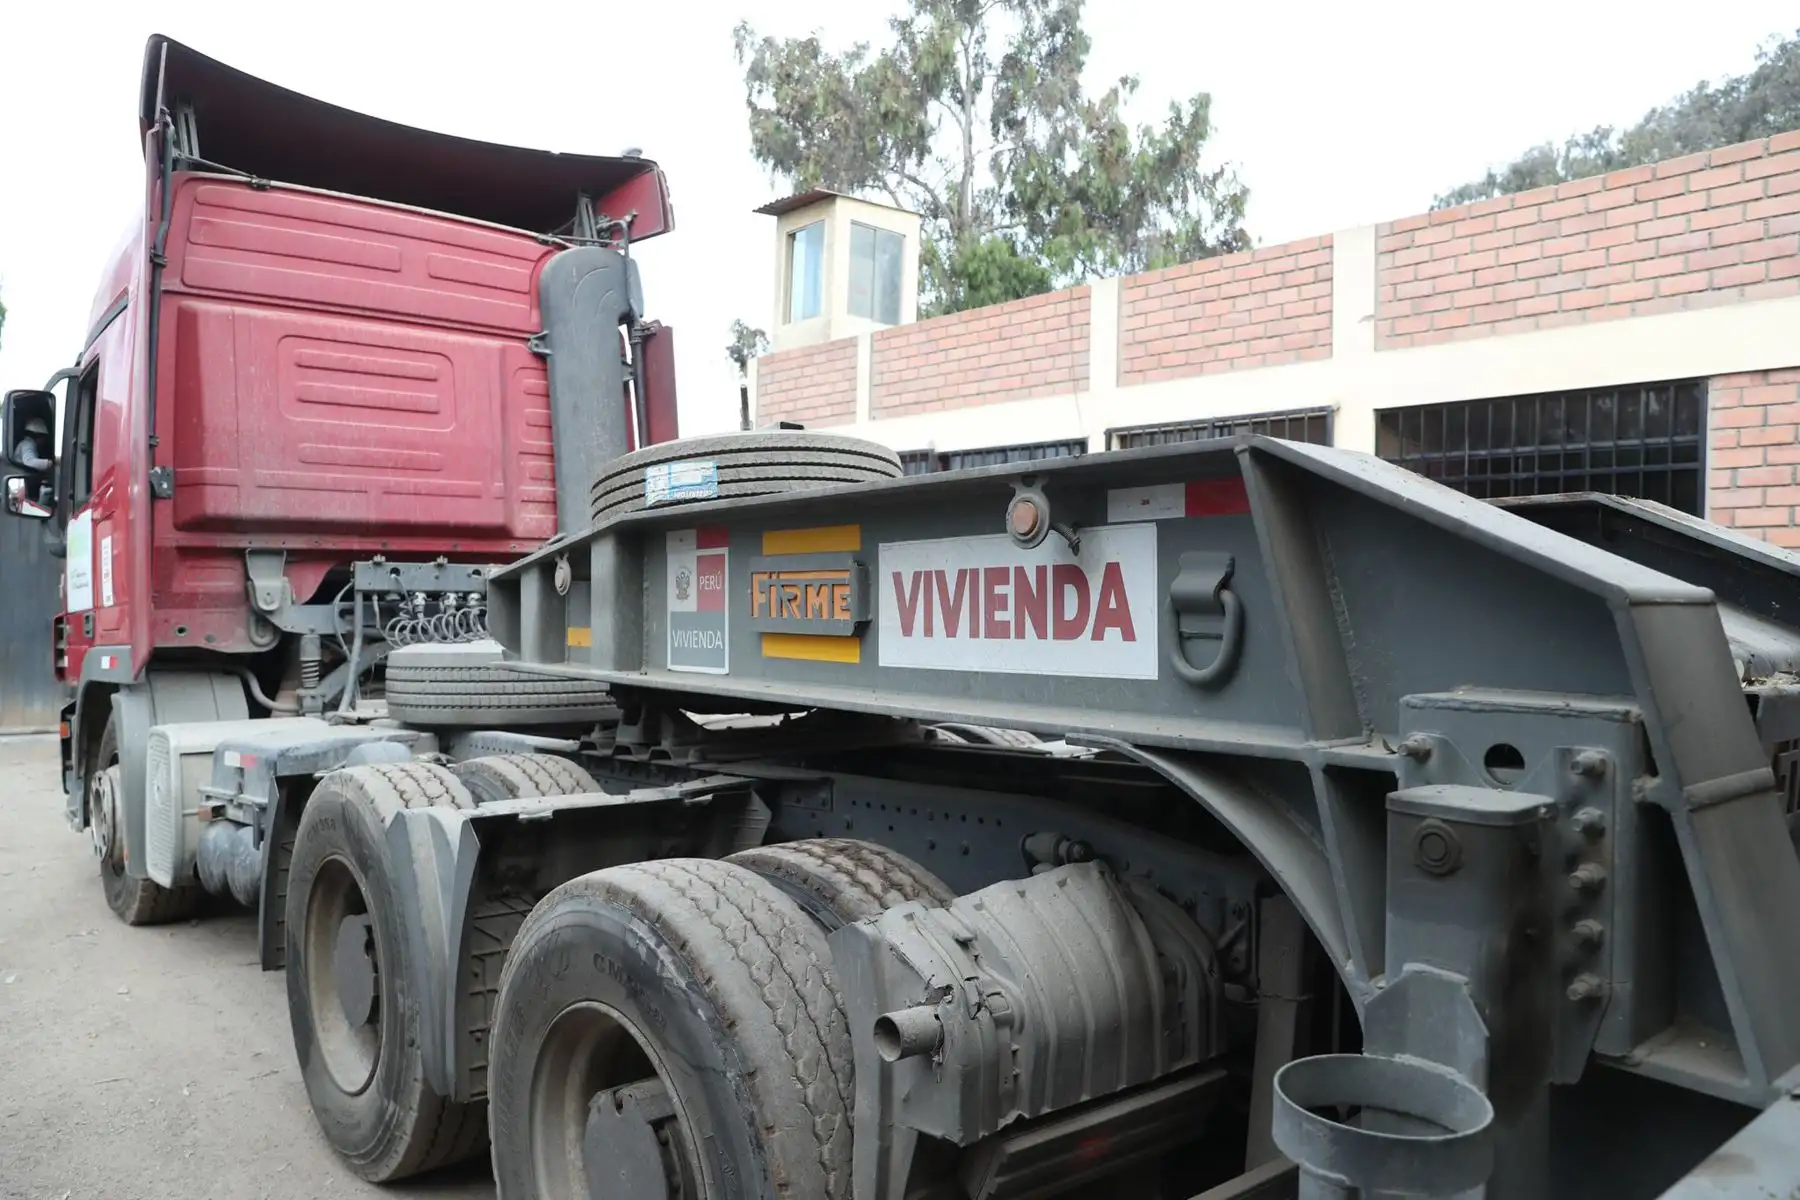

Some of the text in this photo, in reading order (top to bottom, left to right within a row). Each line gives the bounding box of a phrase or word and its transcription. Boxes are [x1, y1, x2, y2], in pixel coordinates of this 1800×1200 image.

[699, 571, 722, 590] PERÚ
[892, 562, 1137, 642] VIVIENDA
[672, 629, 723, 649] VIVIENDA
